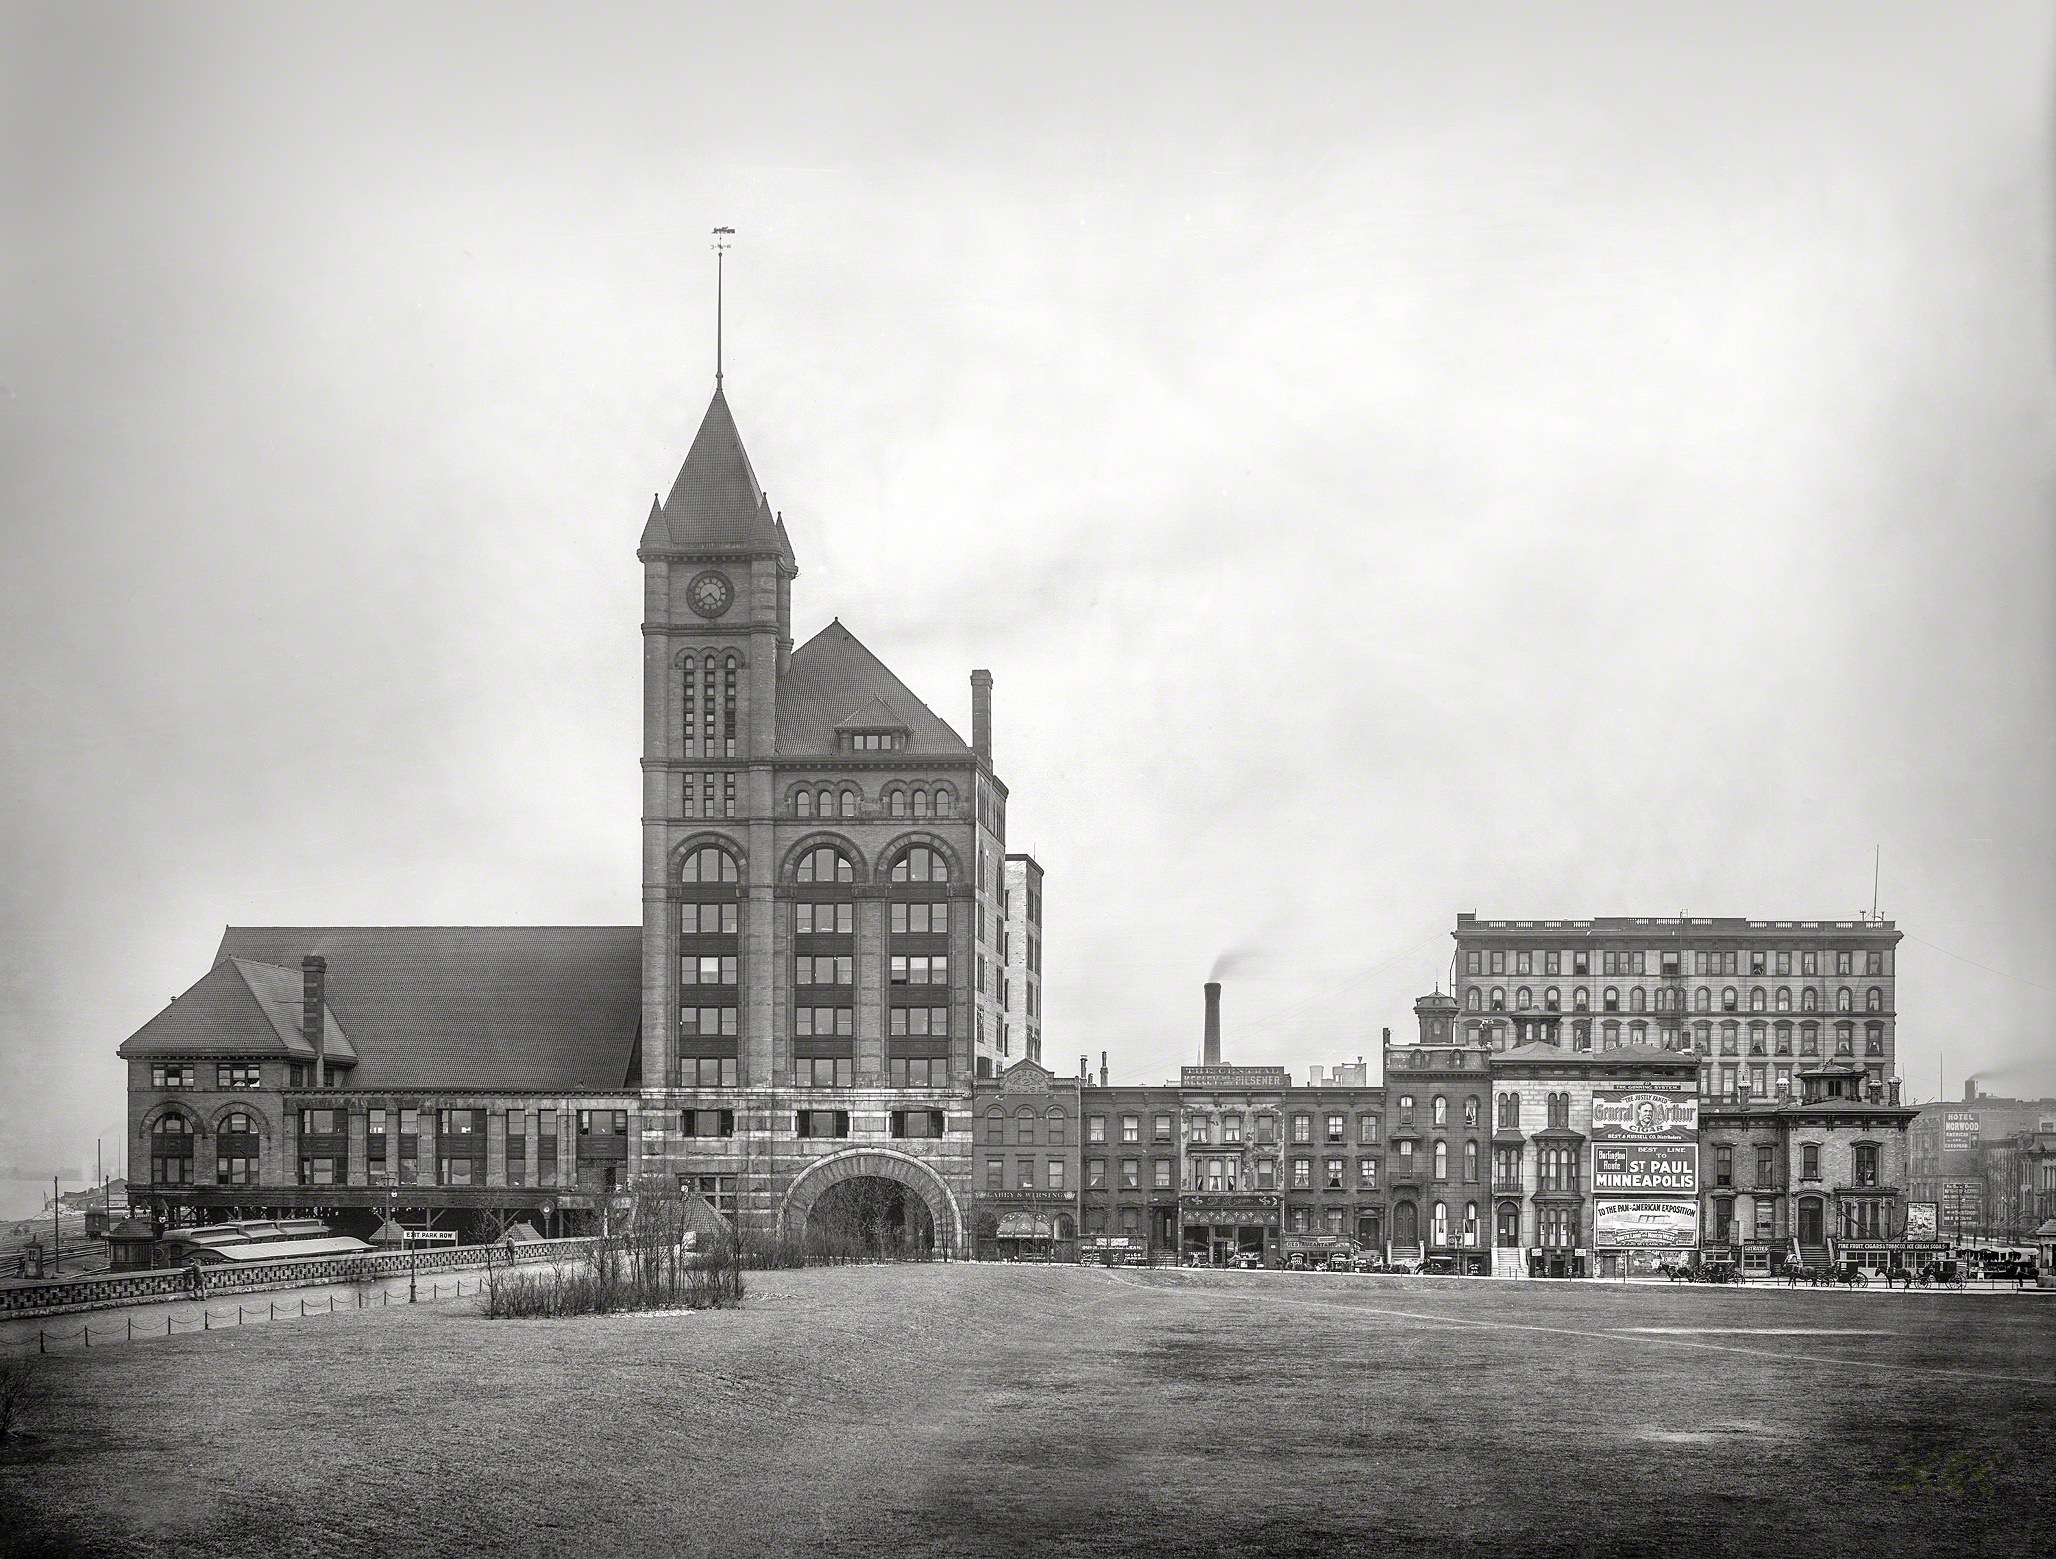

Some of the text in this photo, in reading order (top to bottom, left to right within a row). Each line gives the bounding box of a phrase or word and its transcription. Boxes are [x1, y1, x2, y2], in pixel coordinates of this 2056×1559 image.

[1184, 1076, 1219, 1086] KEELEY
[1593, 1104, 1696, 1124] General Arthur
[1946, 1122, 1979, 1130] NORWOOD
[1598, 1150, 1626, 1161] Burlington
[1603, 1161, 1620, 1170] Route
[1650, 1161, 1692, 1173] PAUL
[1596, 1174, 1694, 1188] MINNEAPOLIS
[1598, 1204, 1696, 1217] TO THE PAN-AMERICAN EXPOSITION
